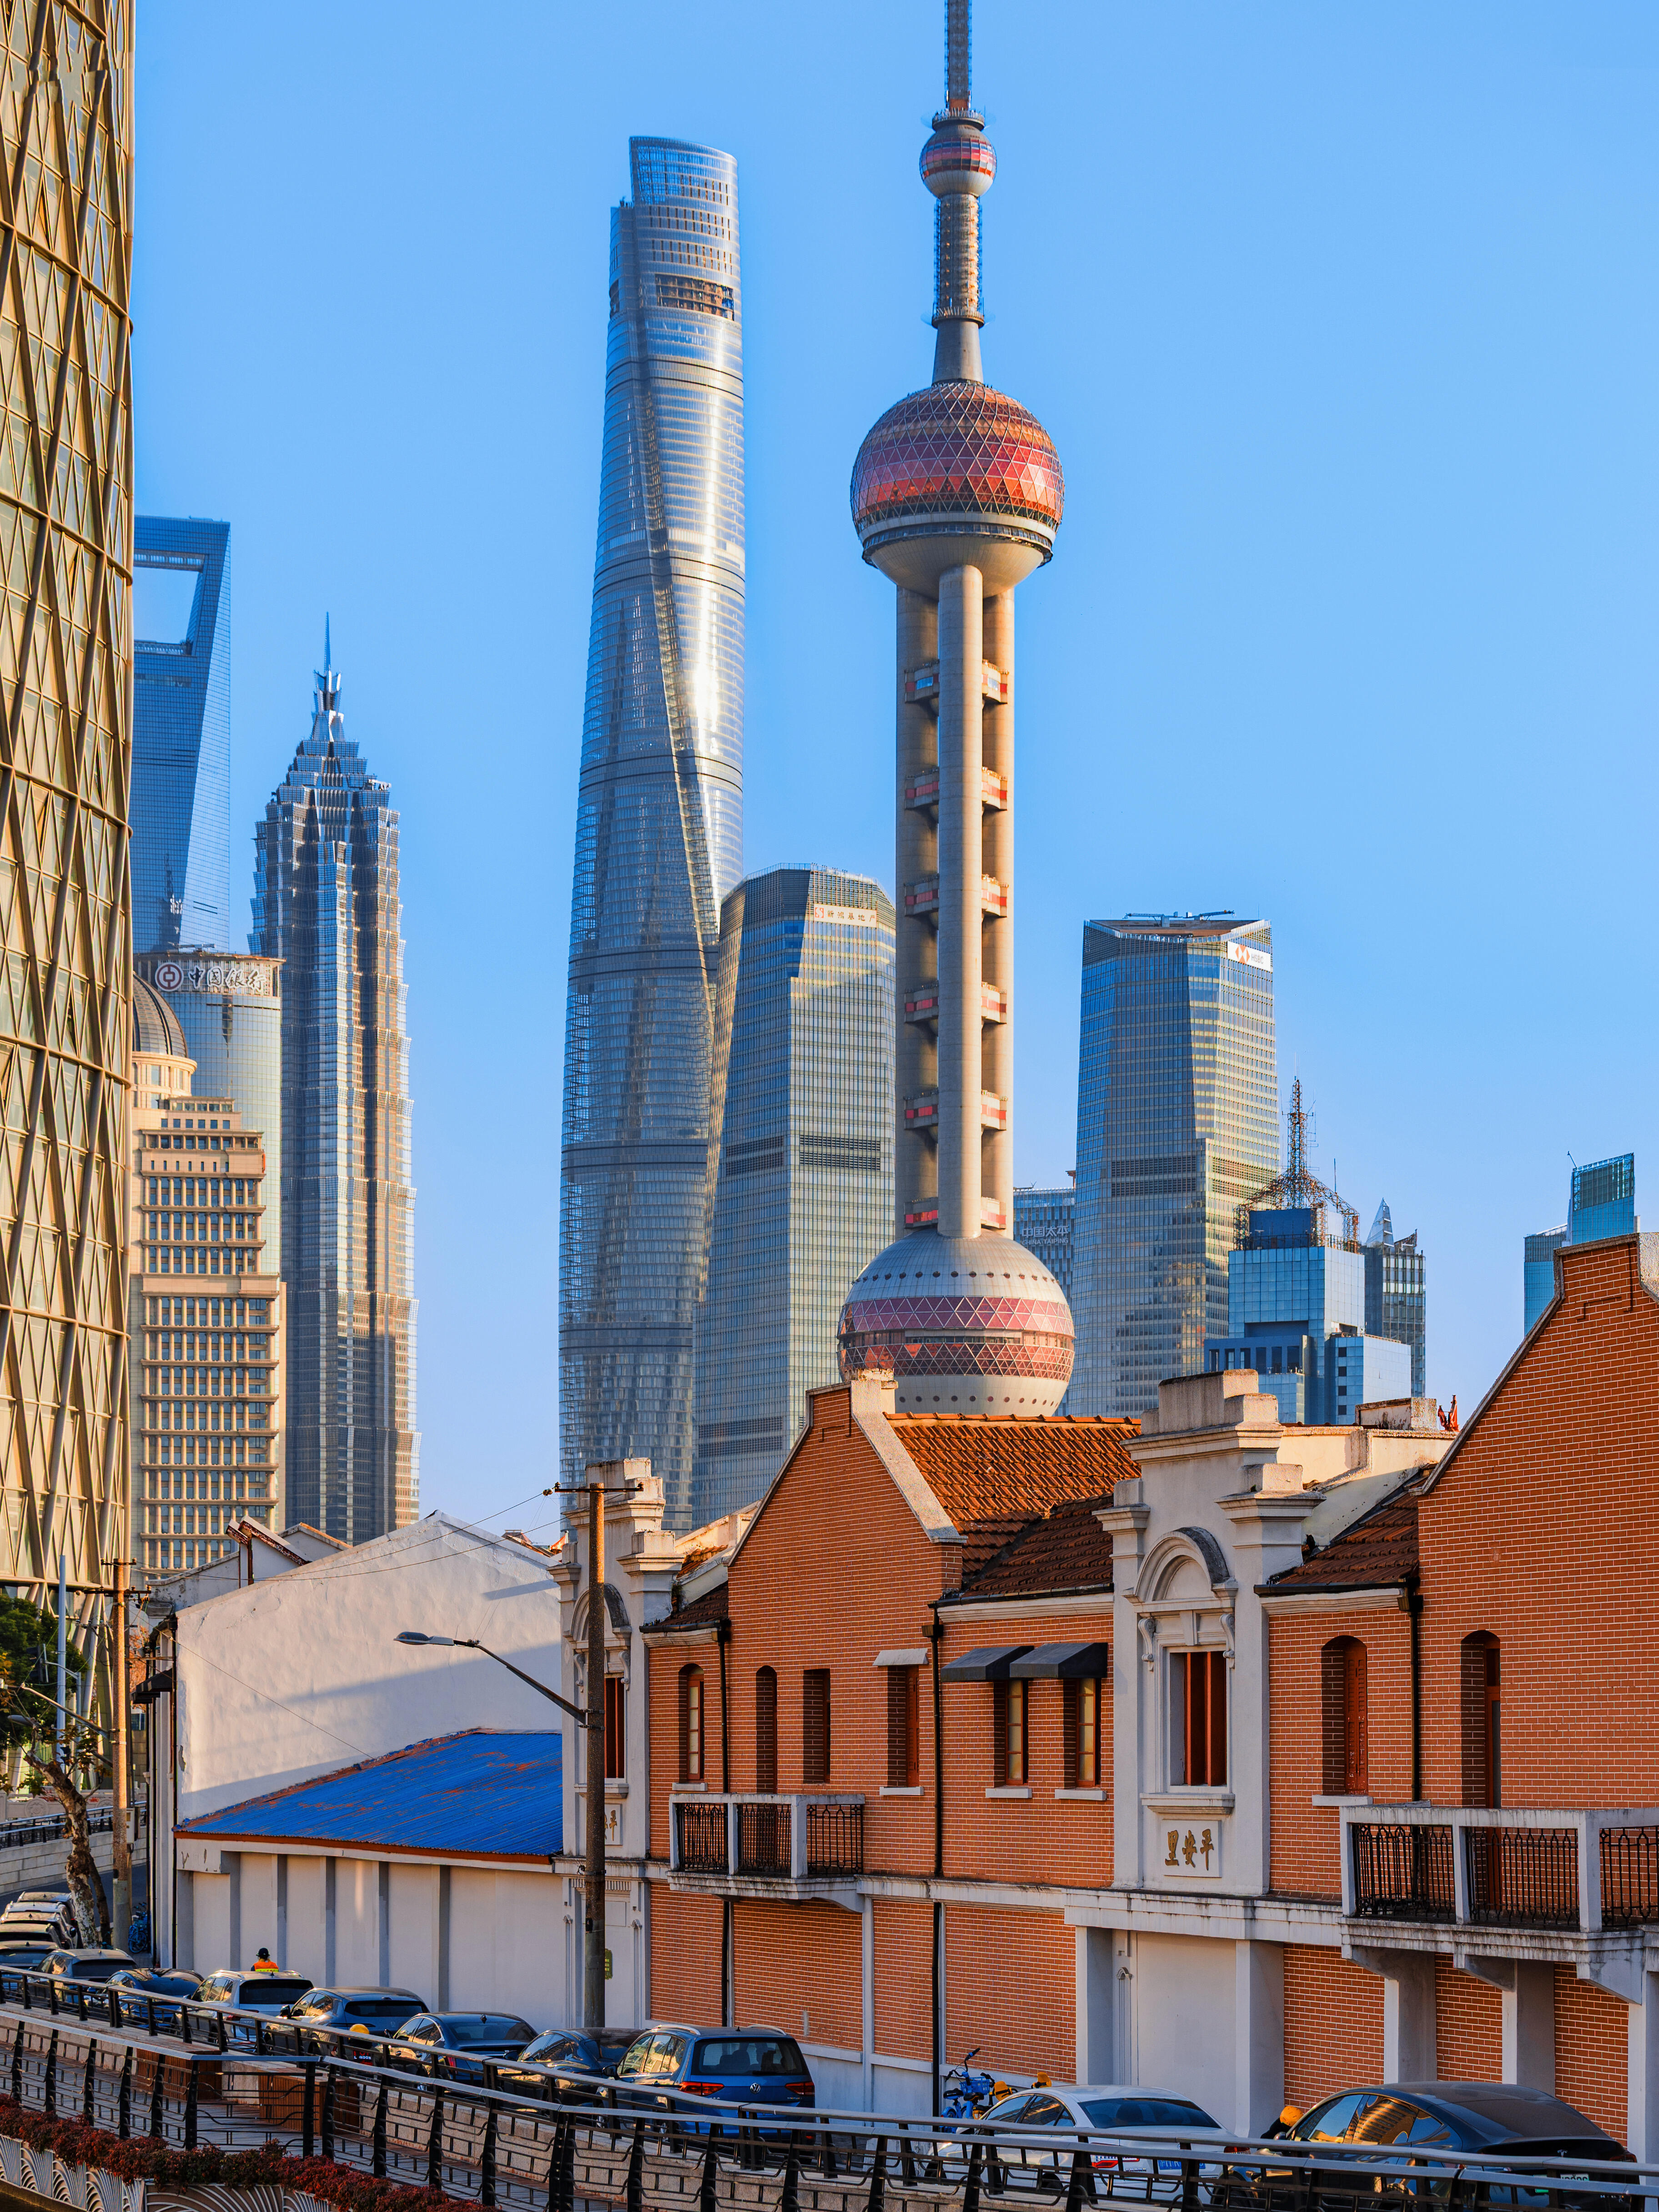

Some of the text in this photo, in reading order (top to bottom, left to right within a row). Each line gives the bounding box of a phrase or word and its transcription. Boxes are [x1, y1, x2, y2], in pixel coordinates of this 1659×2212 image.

[827, 910, 875, 922] 新鸿基地产
[1251, 953, 1264, 964] HSBC
[1022, 1225, 1069, 1238] 中国太平
